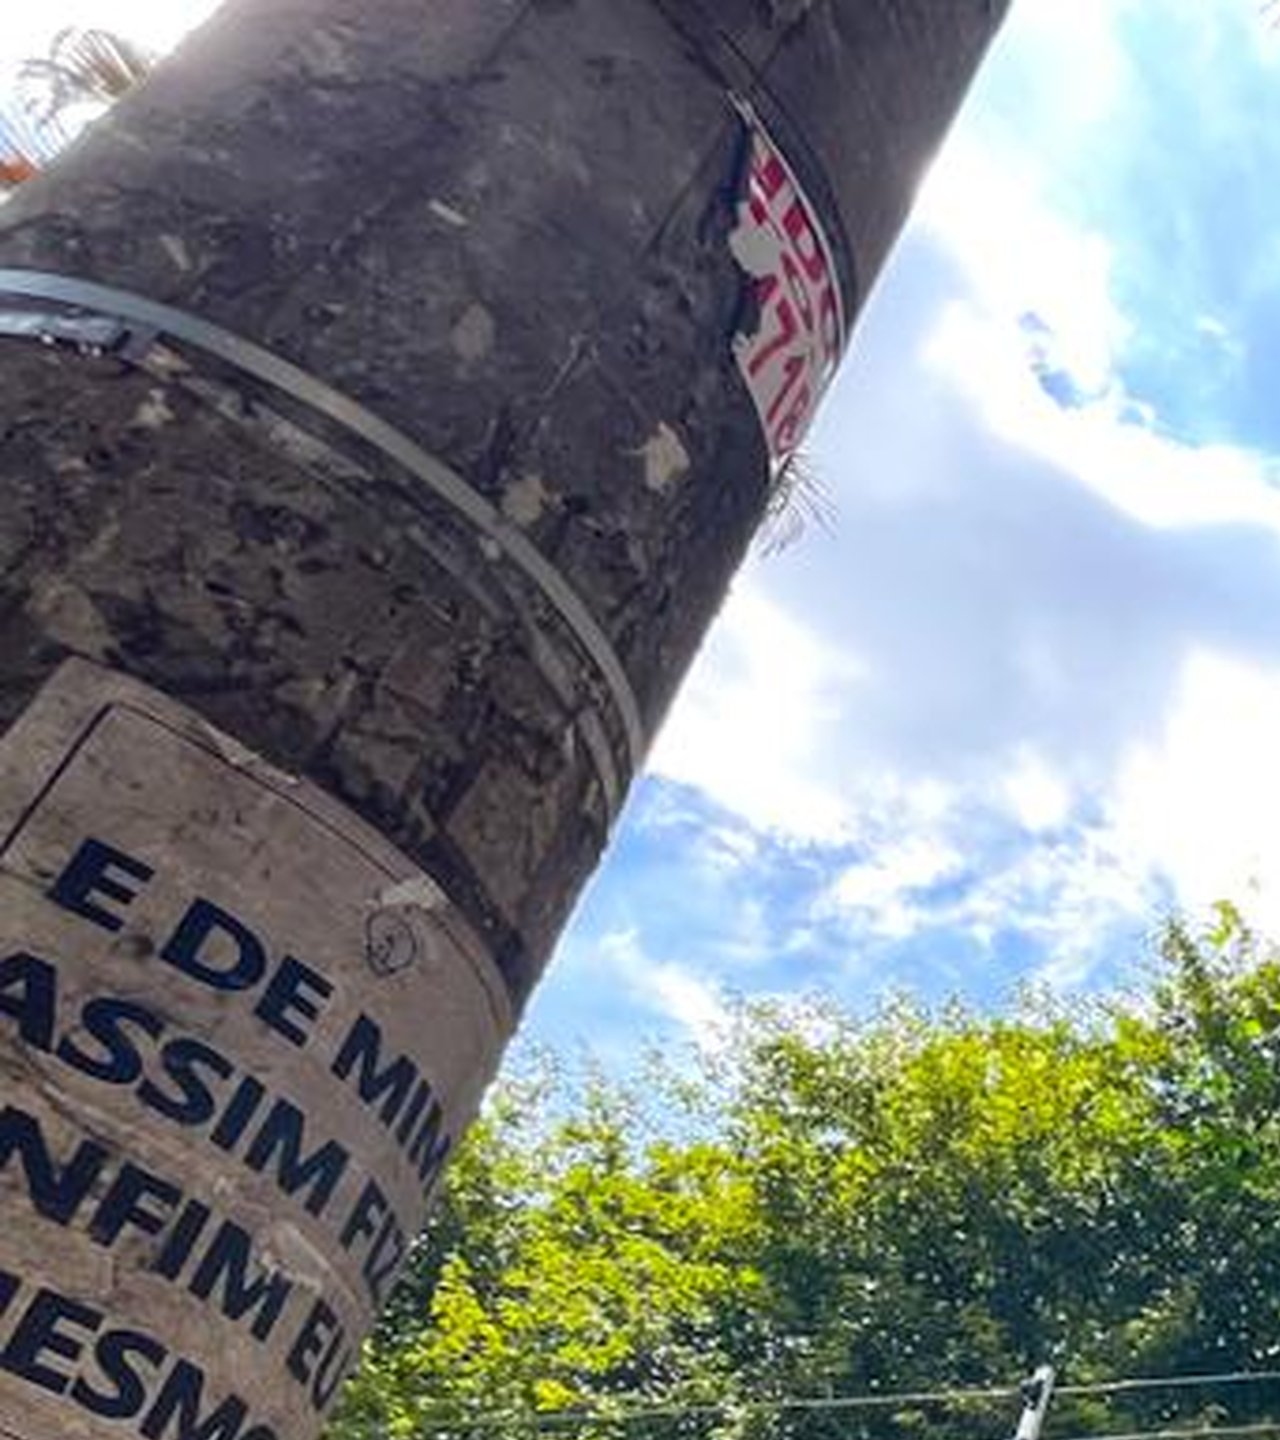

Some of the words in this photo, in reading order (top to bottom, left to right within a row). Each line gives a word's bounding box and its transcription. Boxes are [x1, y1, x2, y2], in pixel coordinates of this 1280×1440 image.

[46, 836, 156, 932] E
[160, 897, 336, 1048] DE
[0, 950, 350, 1218] ASSIM
[285, 1298, 353, 1411] EU
